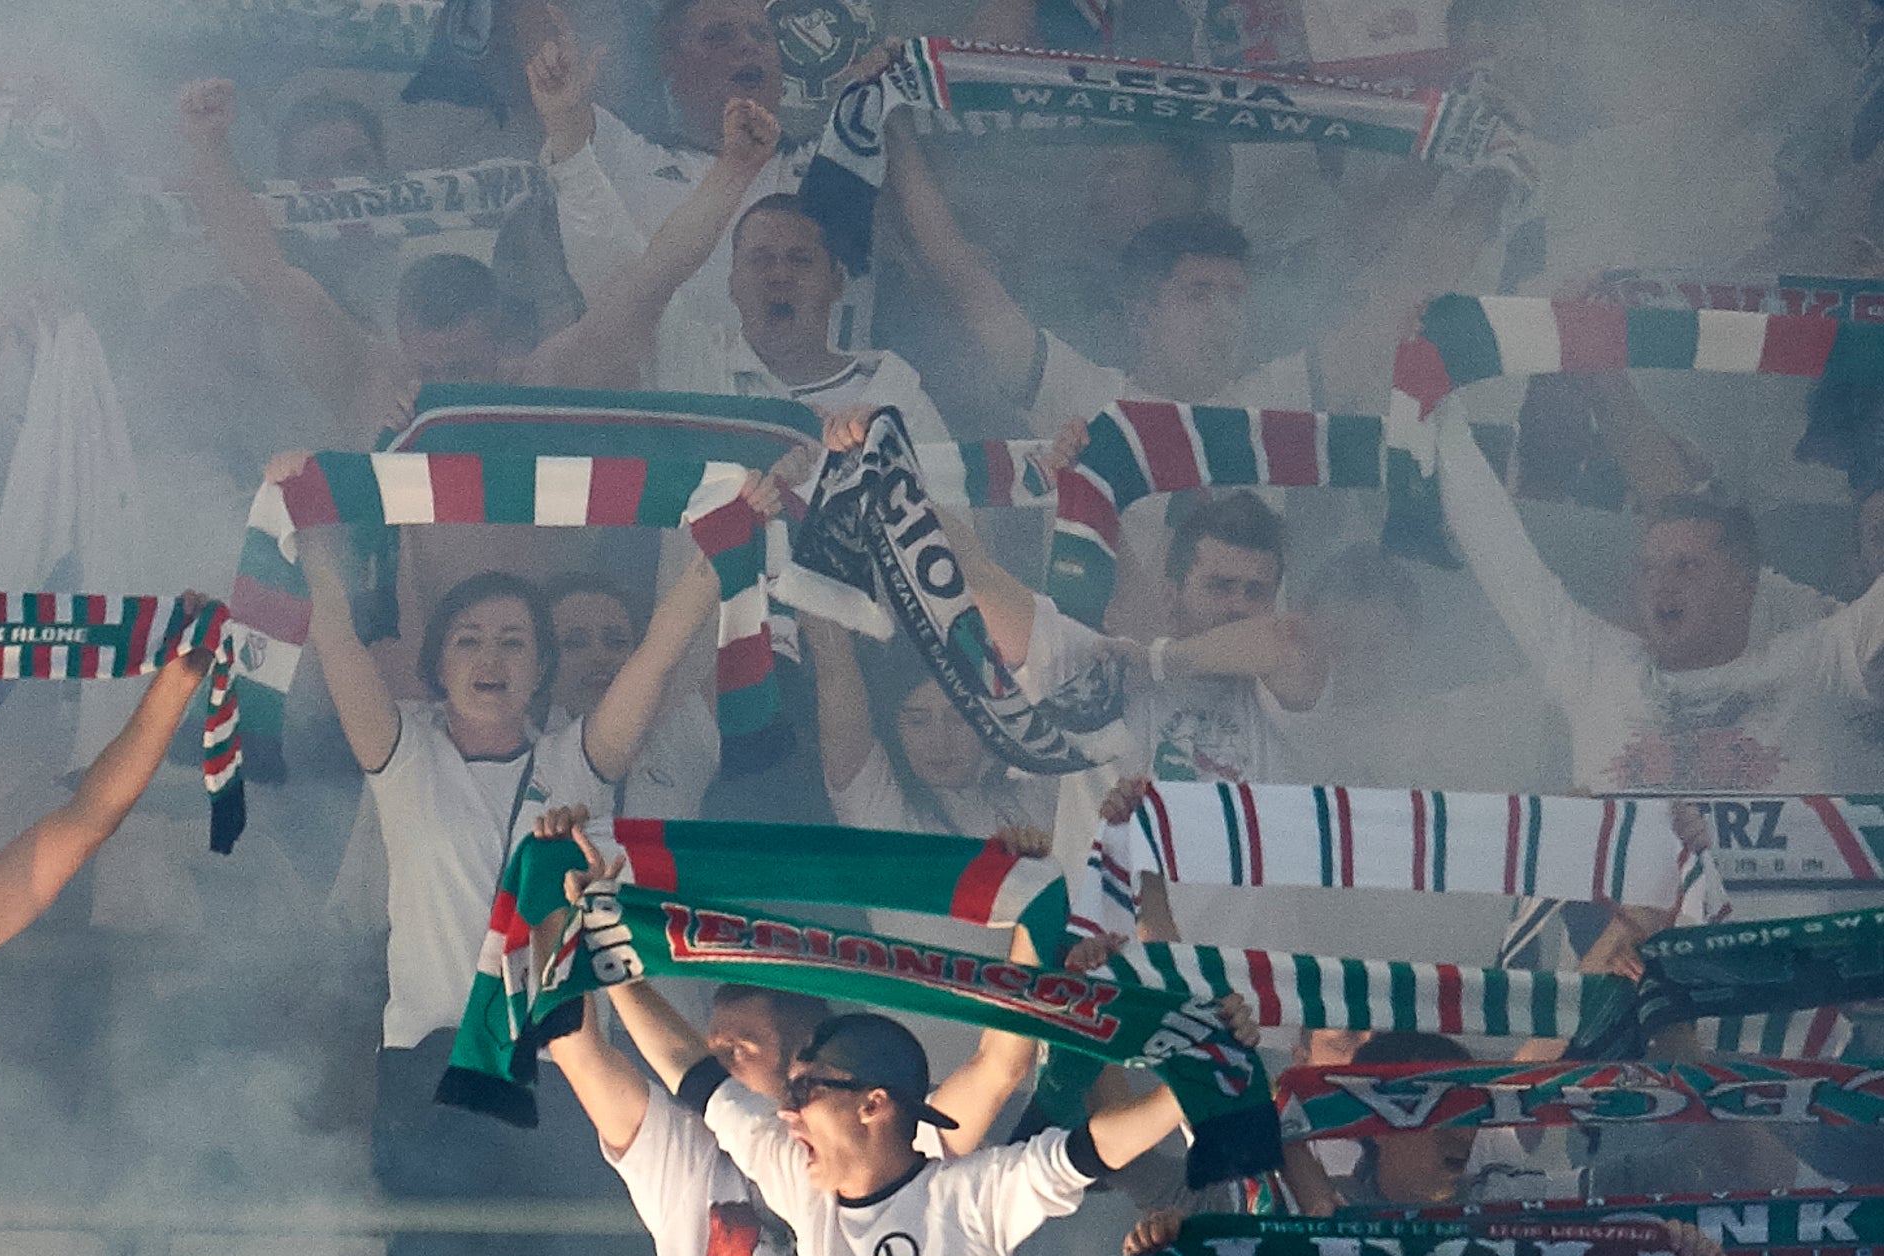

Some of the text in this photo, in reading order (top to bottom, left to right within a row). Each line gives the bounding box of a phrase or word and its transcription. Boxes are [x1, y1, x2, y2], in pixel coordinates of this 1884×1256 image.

[1011, 84, 1352, 141] WARSZAWA
[11, 627, 88, 645] ALONE
[1704, 926, 1791, 950] moje
